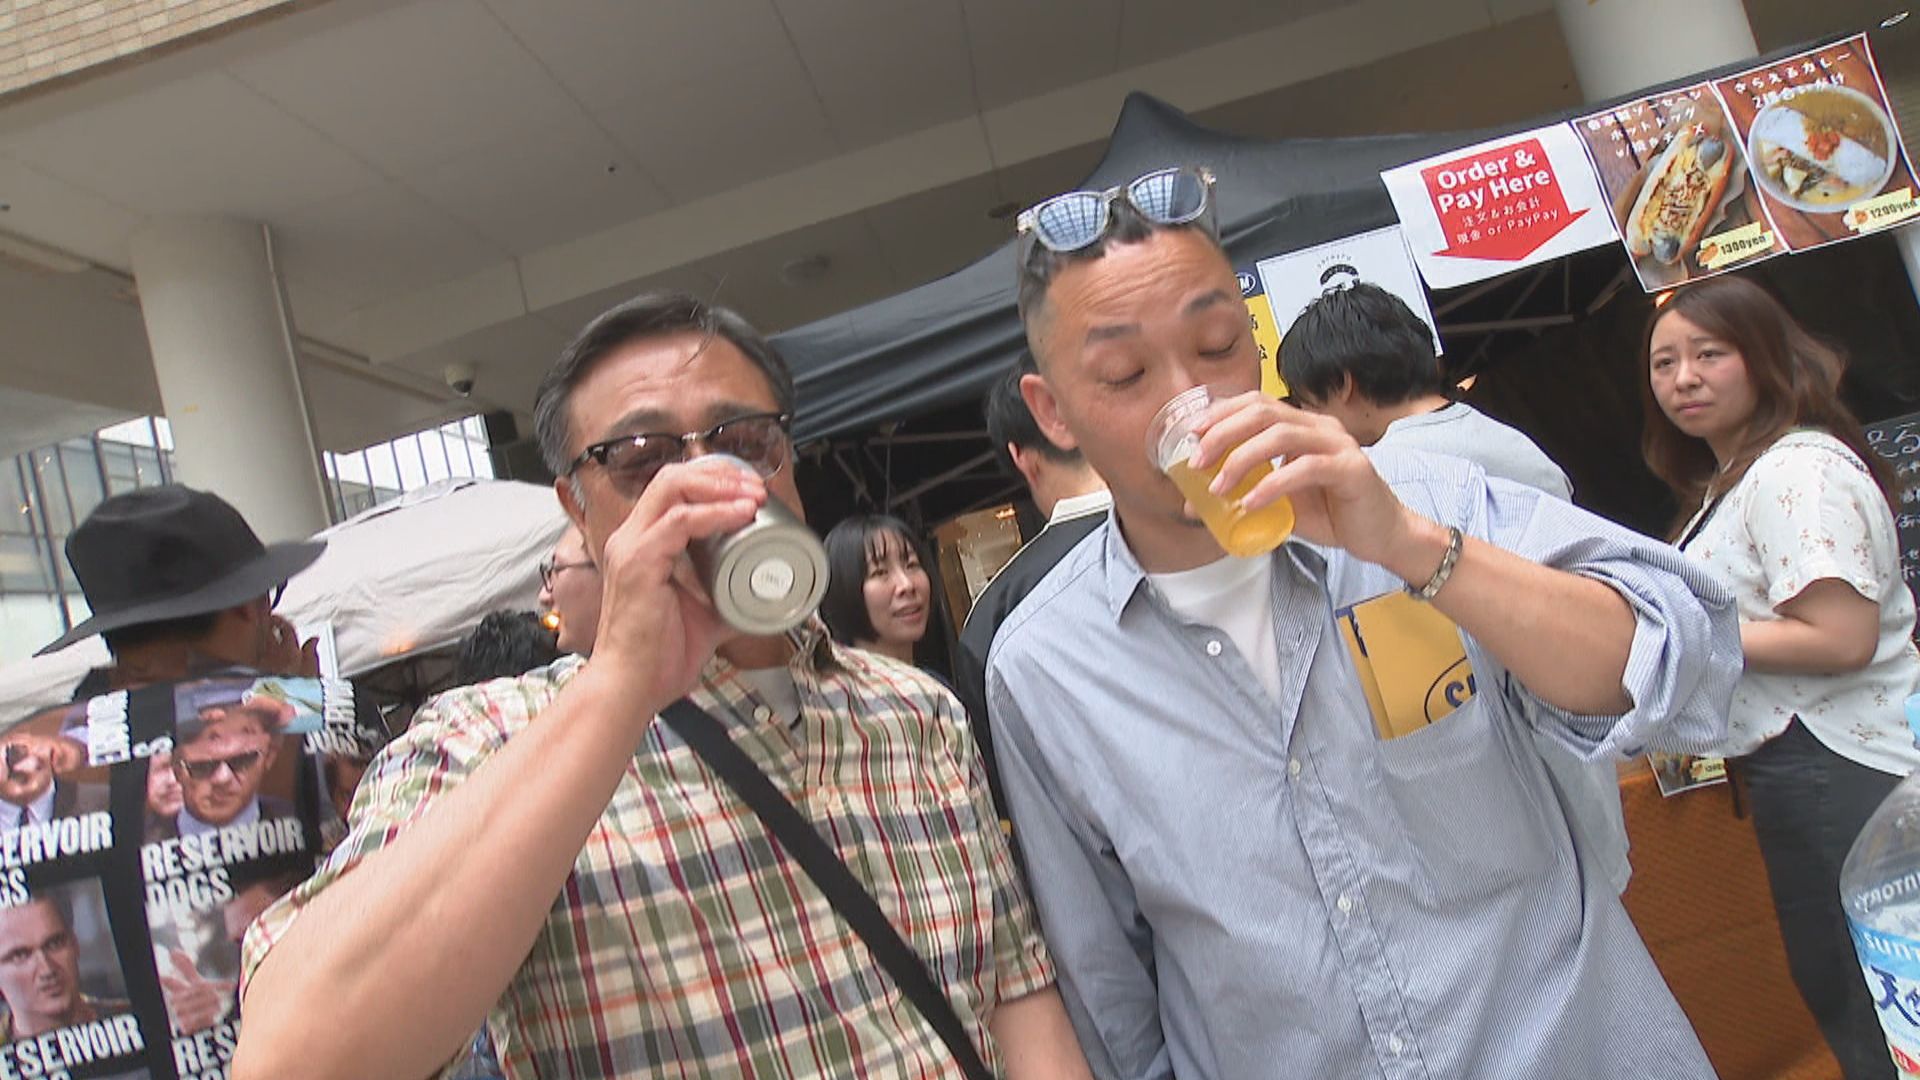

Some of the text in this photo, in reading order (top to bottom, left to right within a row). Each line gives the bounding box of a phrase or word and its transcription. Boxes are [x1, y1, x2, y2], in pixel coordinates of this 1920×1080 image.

[1437, 149, 1536, 190] Order &
[1437, 169, 1551, 215] Pay Here
[1457, 208, 1560, 245] 現金 or PayPay
[1870, 200, 1917, 219] 1200yen
[1720, 233, 1766, 255] 1300yen
[0, 811, 113, 869] ERVOIR
[140, 816, 305, 881] RESERVOIR
[146, 867, 235, 924] DOGS
[171, 1020, 240, 1077] RES
